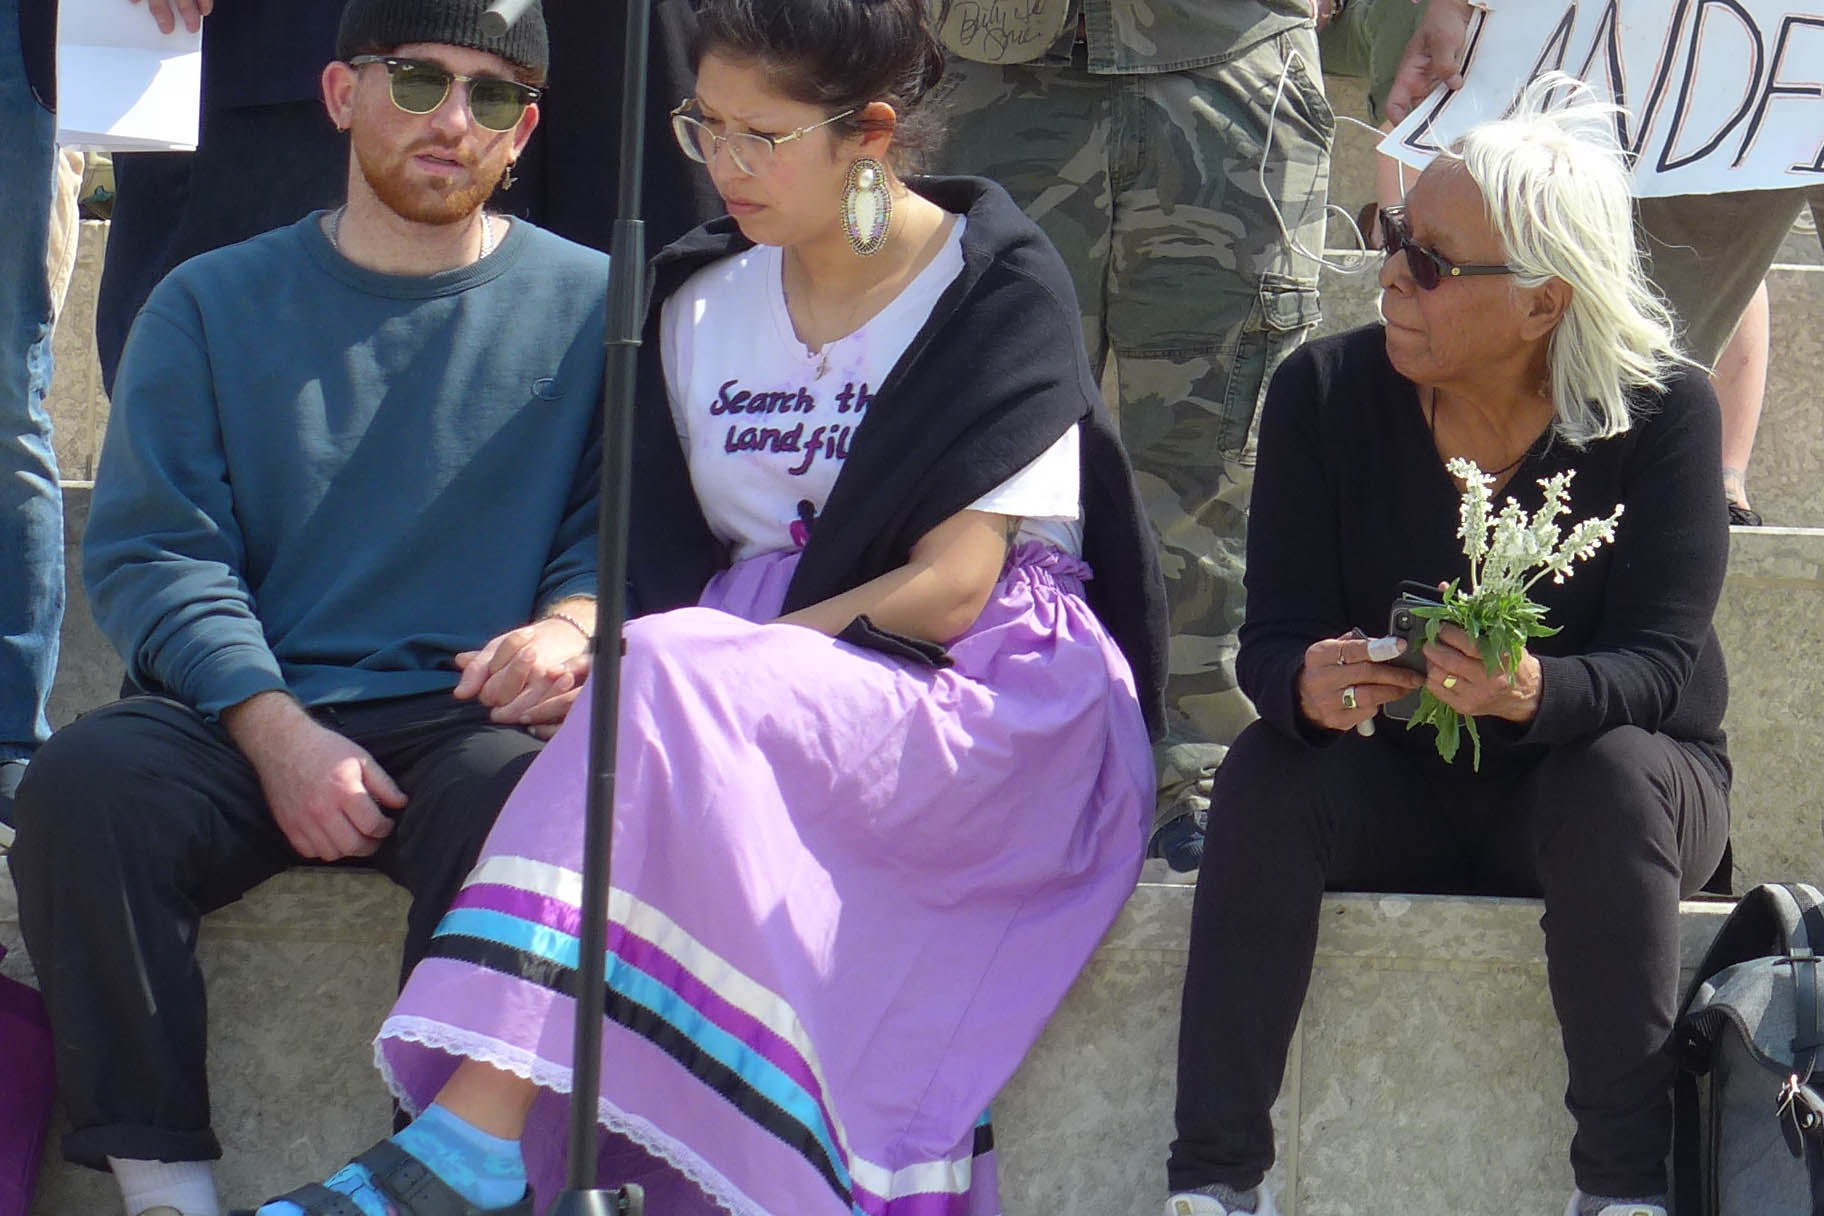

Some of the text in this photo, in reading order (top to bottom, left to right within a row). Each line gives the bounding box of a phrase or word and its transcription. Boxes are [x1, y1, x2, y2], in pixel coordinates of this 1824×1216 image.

[709, 379, 877, 417] Search th
[724, 422, 854, 475] Landfil
